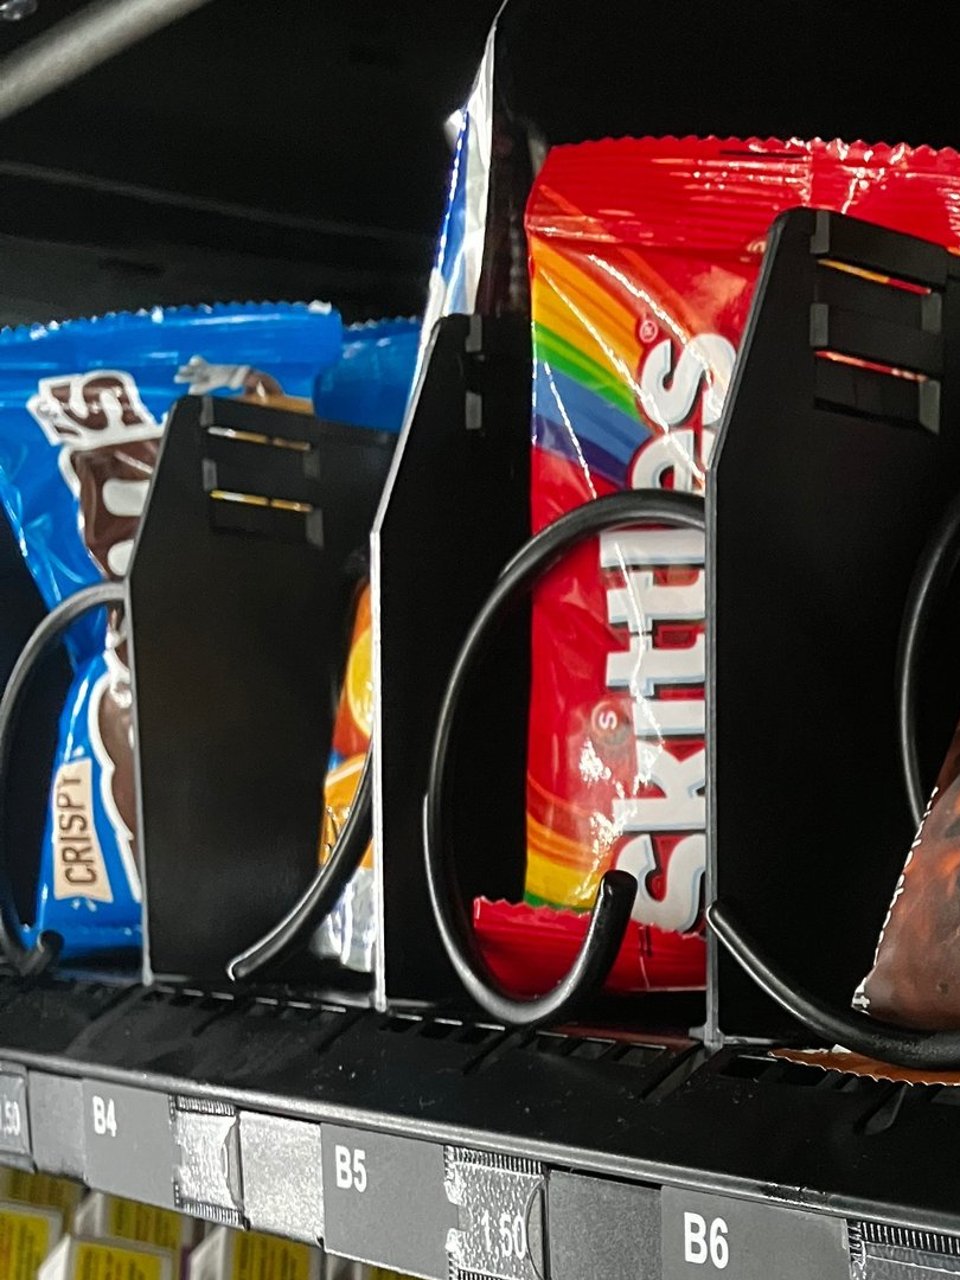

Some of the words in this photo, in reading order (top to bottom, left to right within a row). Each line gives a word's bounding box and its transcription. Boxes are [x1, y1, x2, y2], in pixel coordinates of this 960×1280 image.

[92, 1095, 117, 1138] B4
[335, 1144, 367, 1193] B5
[480, 1209, 527, 1264] 1,50
[683, 1212, 729, 1269] B6
